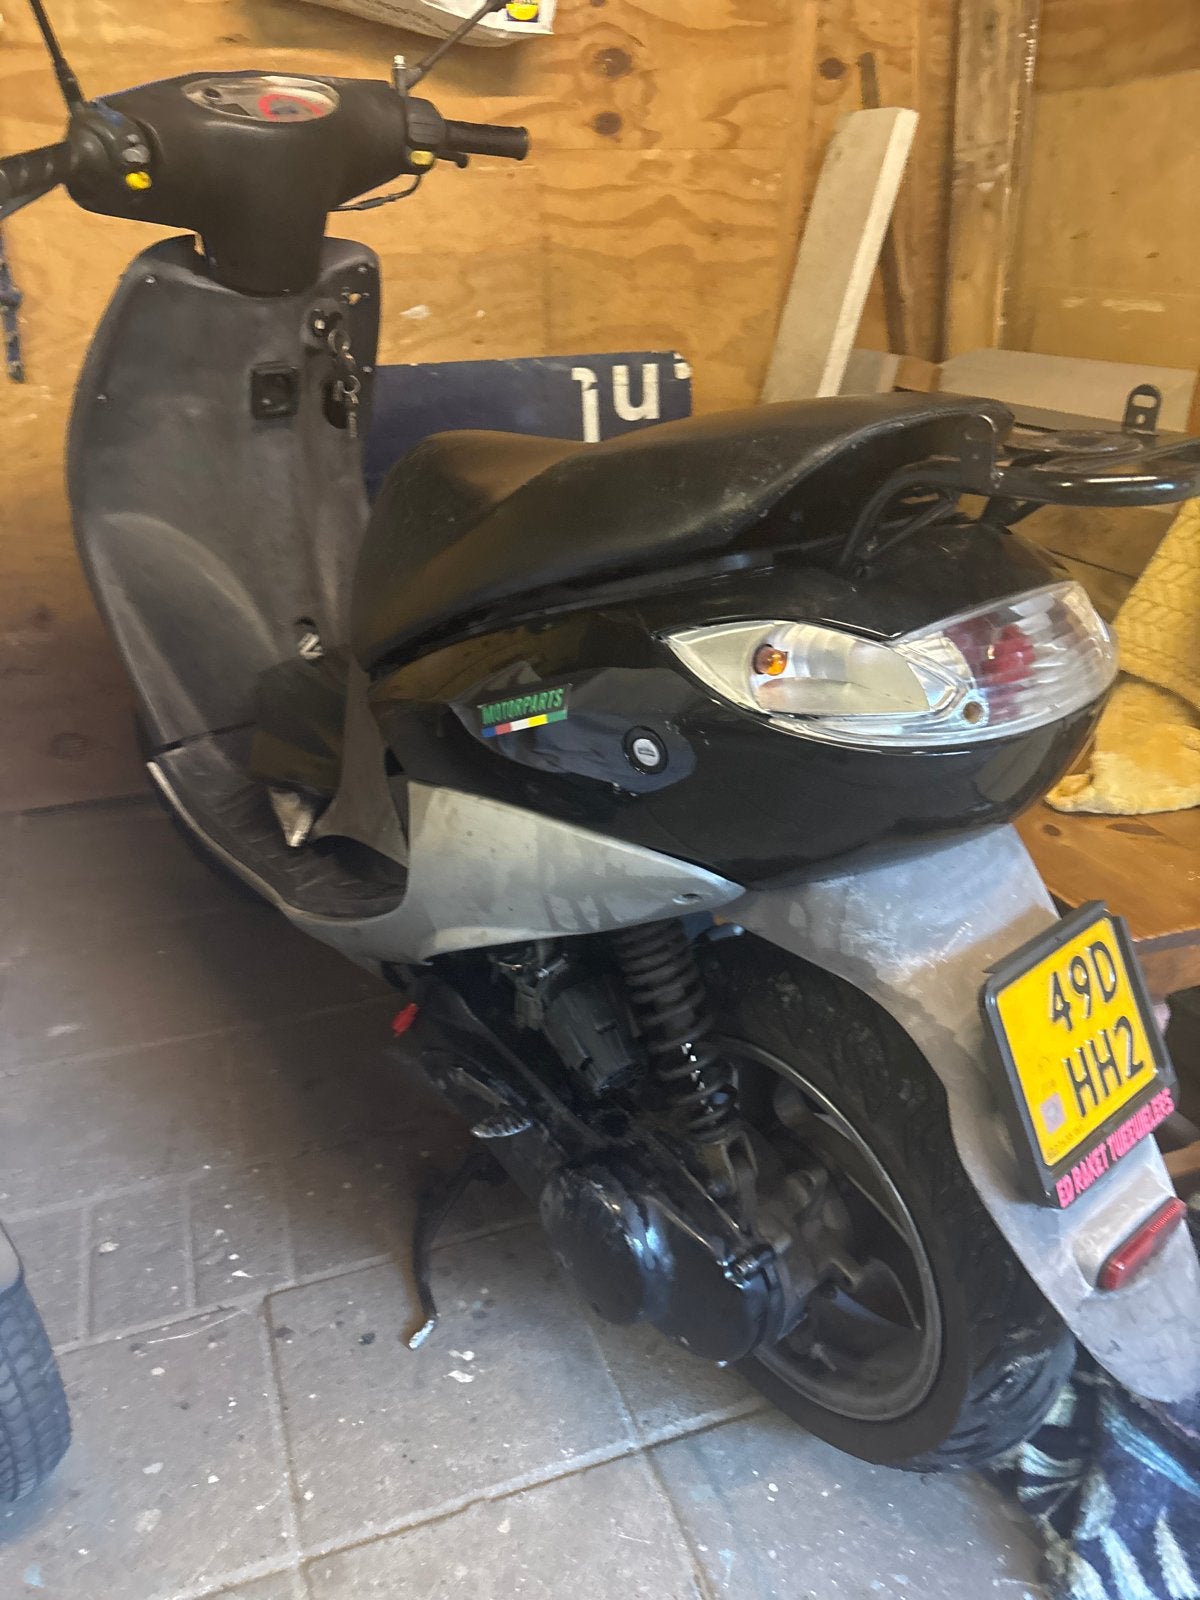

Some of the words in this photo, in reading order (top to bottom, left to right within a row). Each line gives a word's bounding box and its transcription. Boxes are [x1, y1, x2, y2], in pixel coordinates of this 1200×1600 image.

[481, 688, 564, 725] MOTORPARTS
[1050, 941, 1117, 1032] 49D
[1063, 1015, 1144, 1117] HH2
